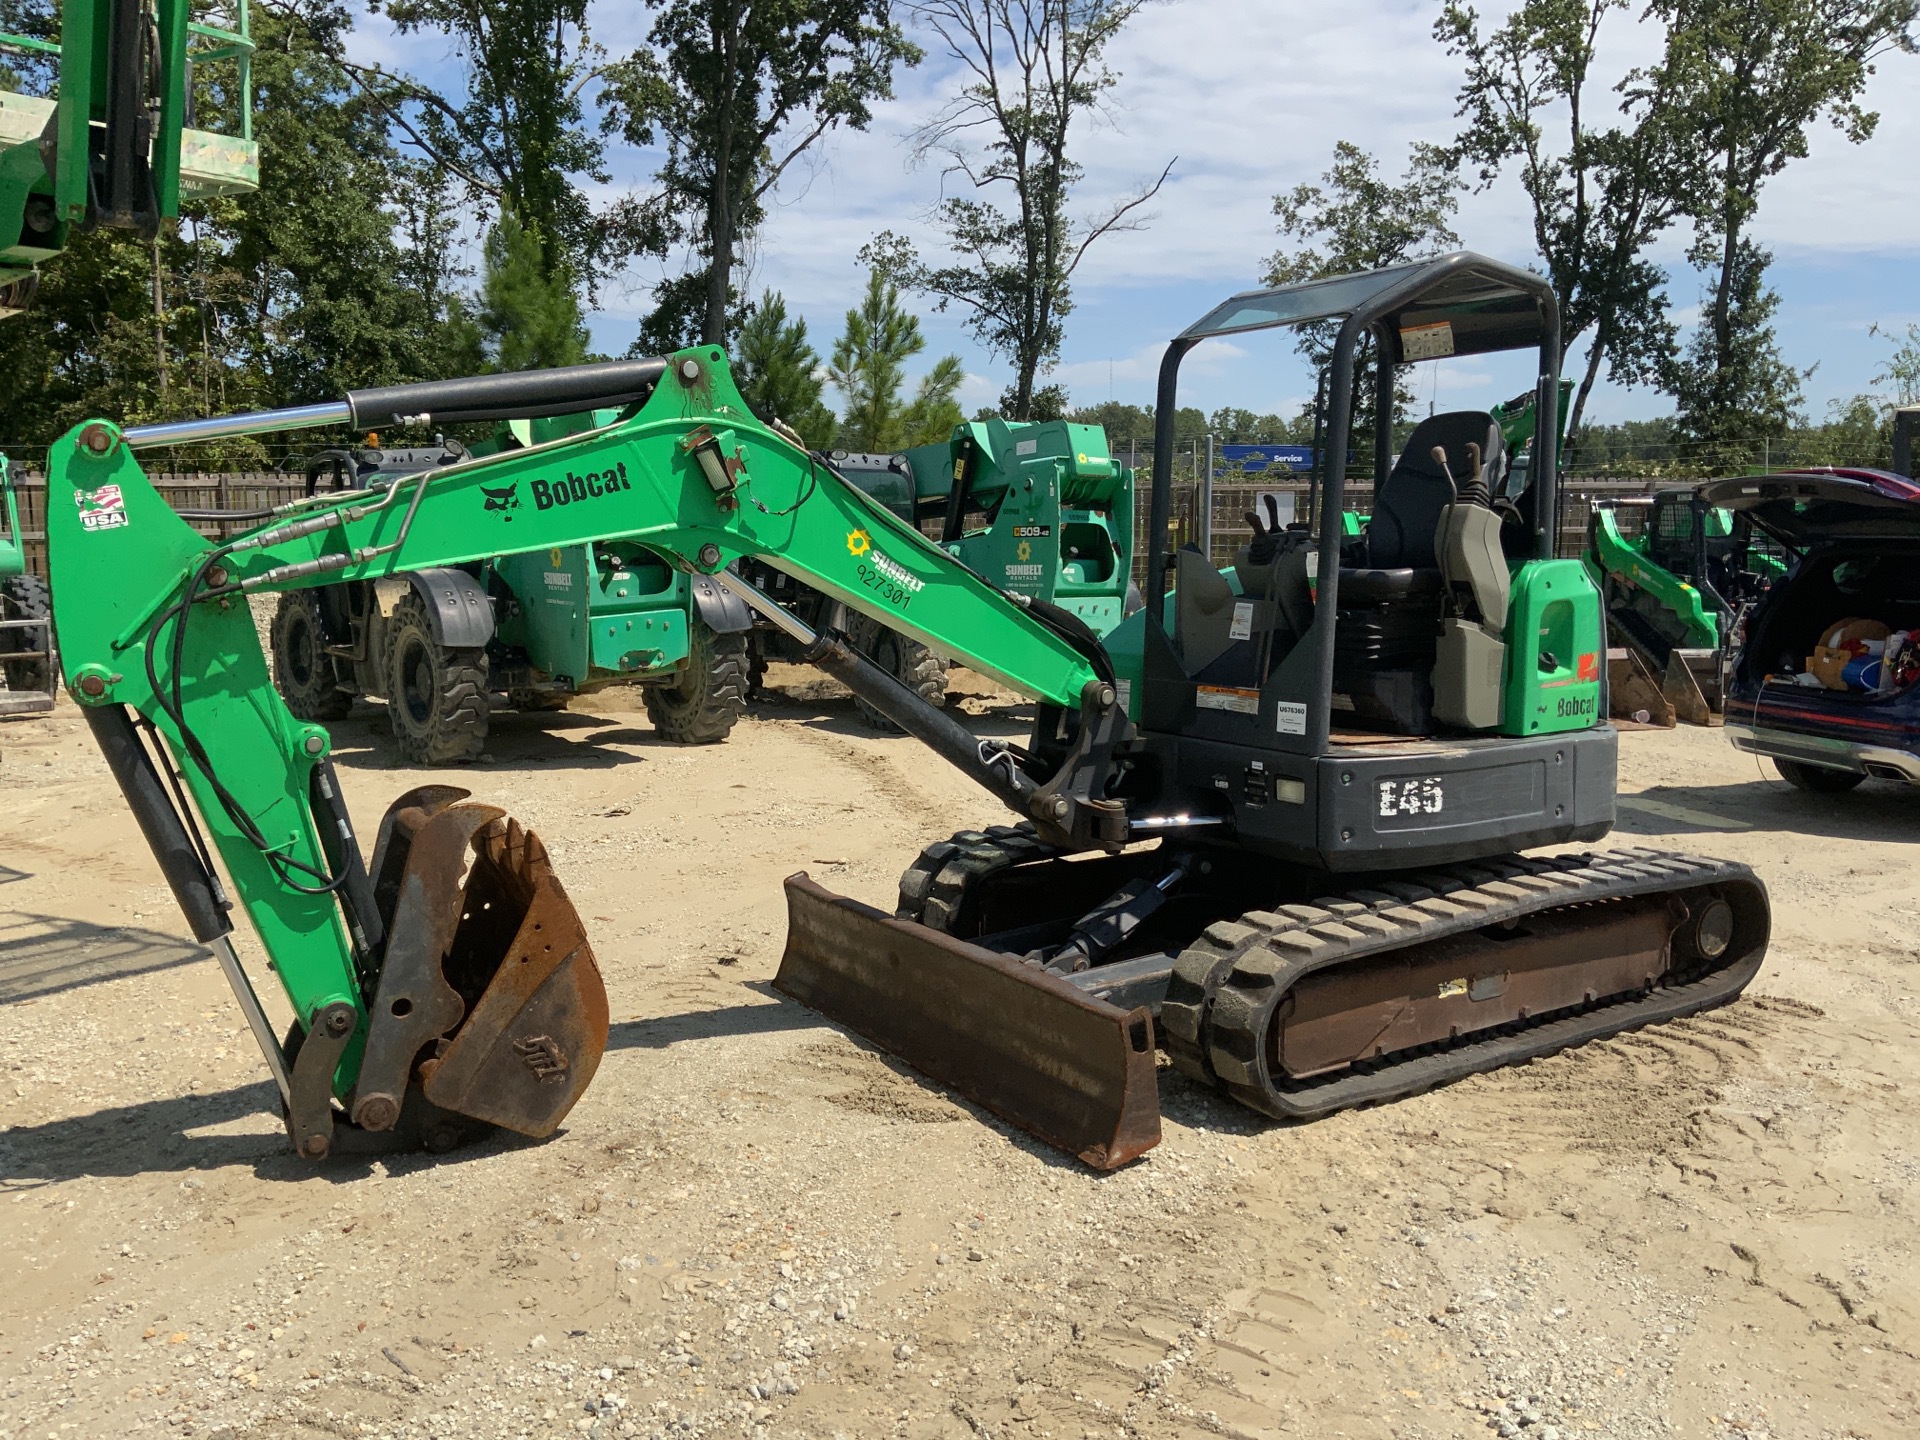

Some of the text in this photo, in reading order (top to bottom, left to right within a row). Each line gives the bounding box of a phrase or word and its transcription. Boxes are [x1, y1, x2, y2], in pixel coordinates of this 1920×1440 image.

[1273, 454, 1303, 463] Service
[530, 461, 631, 511] Bobcat
[83, 512, 124, 527] USA
[869, 549, 926, 592] SUNBELT
[1005, 564, 1043, 576] SUNBELT
[856, 564, 912, 611] 927301
[1556, 695, 1595, 718] Bobcat
